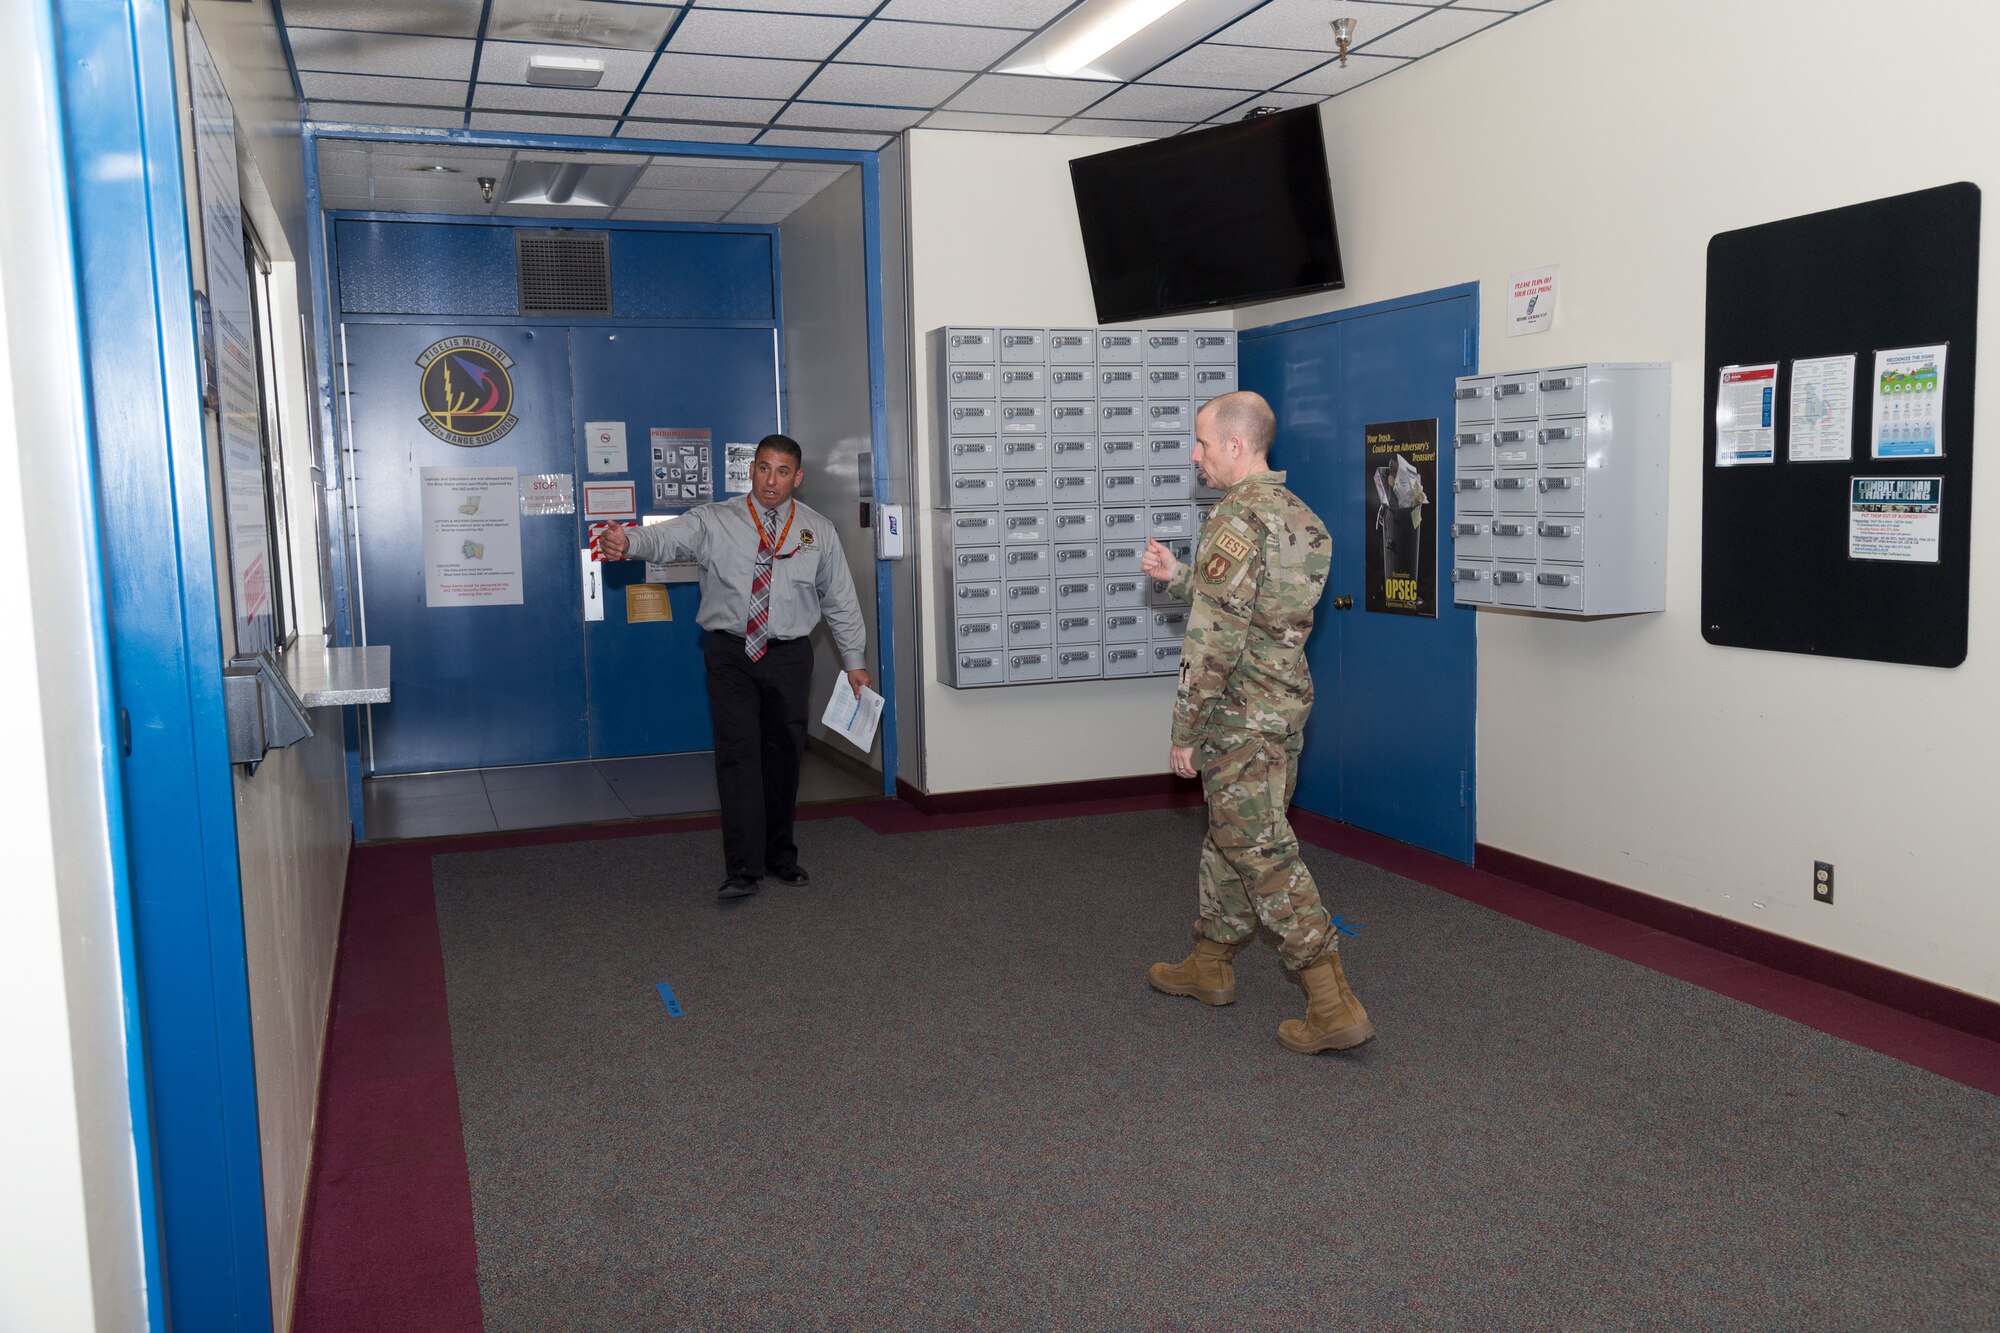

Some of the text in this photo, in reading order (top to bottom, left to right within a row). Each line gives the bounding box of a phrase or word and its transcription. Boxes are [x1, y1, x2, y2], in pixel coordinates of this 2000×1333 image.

[1515, 276, 1552, 290] PLEASE TURN OFF
[1514, 290, 1526, 298] YOUR
[1538, 285, 1552, 294] PHONE
[424, 338, 506, 362] FIDELIS MISSIONI
[445, 432, 474, 444] RANGE
[476, 416, 515, 444] SQUADRON
[1367, 433, 1395, 443] Your Trash...
[1372, 445, 1386, 453] Could
[1387, 444, 1393, 452] be
[1401, 441, 1429, 452] Adversary's
[1412, 451, 1436, 462] Treasure!
[533, 482, 558, 490] STOP!
[1859, 481, 1931, 492] COMBAT HUMAN
[1860, 491, 1930, 500] TRAFFICKING
[1220, 533, 1248, 558] TEST
[1386, 578, 1417, 601] OPSEC
